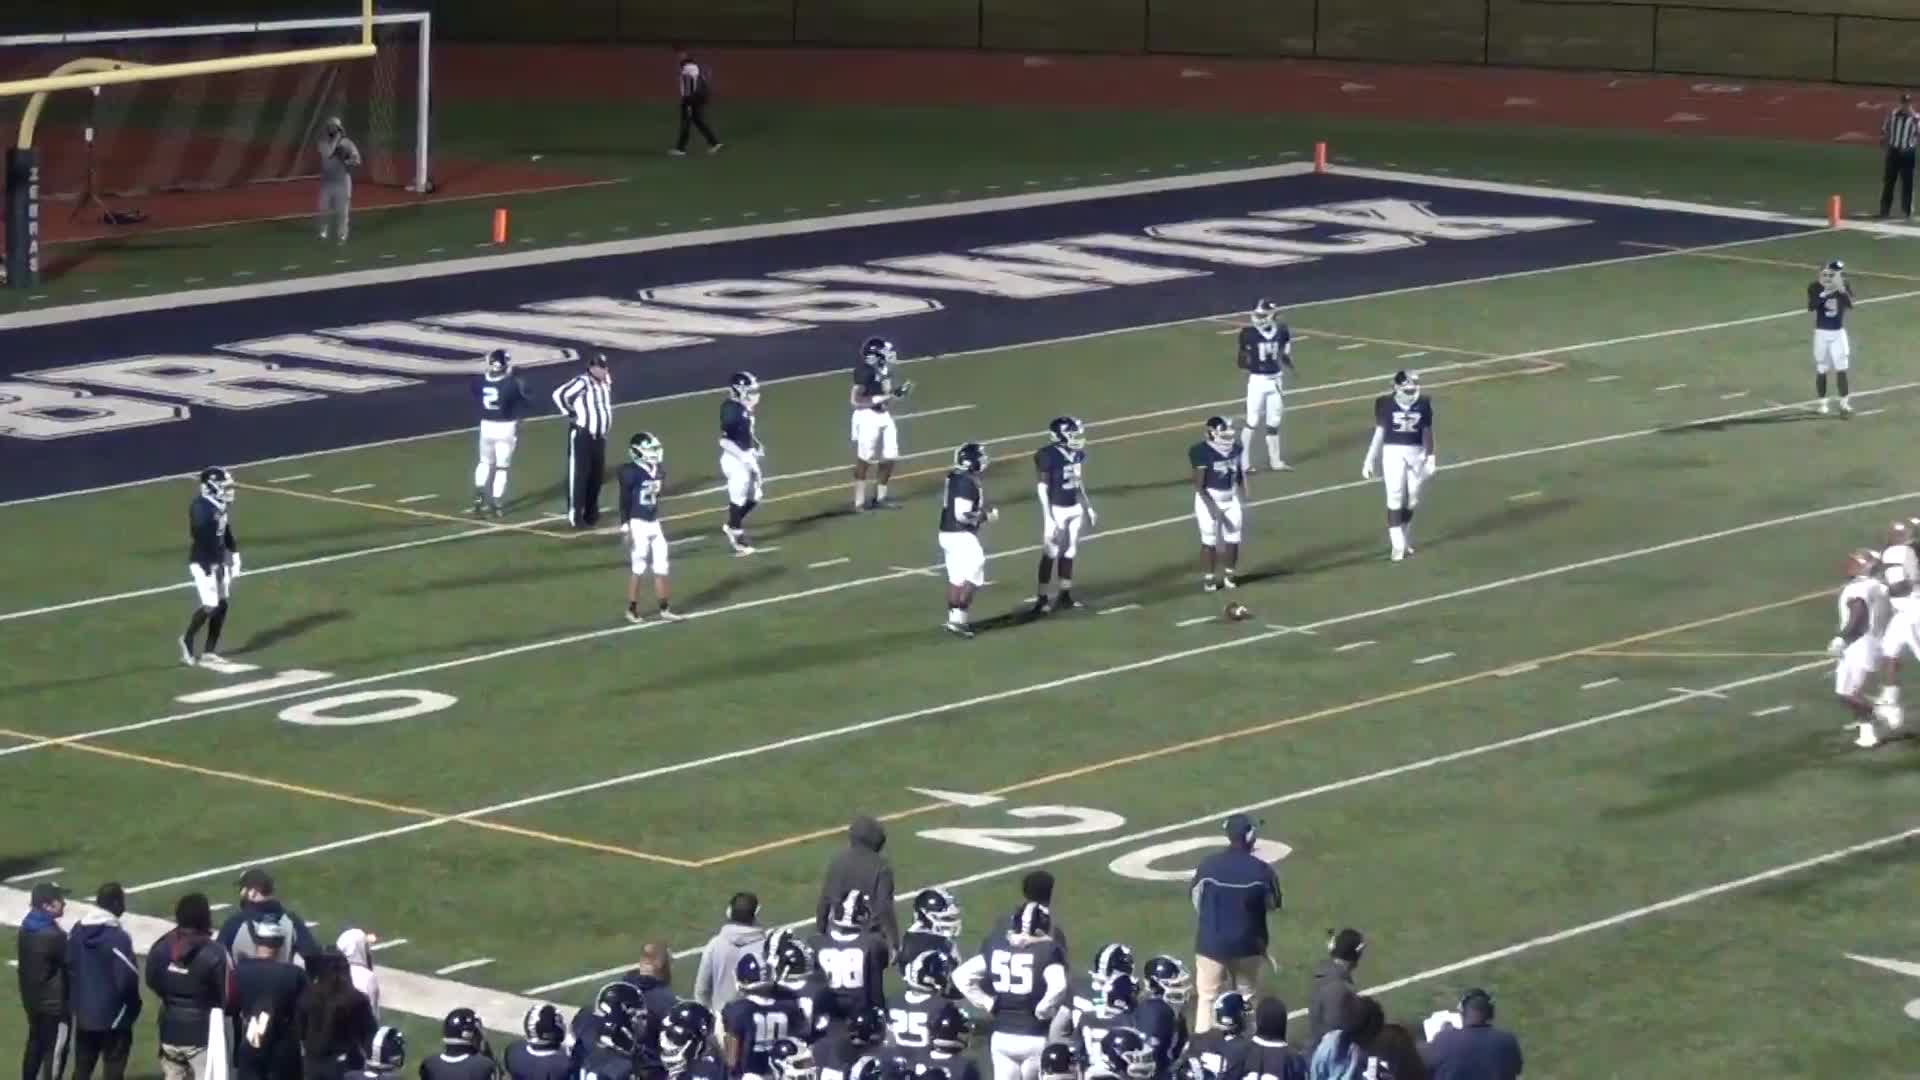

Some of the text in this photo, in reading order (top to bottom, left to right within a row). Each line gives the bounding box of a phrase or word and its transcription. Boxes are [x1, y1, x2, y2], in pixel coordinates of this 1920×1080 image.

[0, 198, 1596, 440] BRUNSWICK
[482, 386, 500, 410] 2
[174, 668, 459, 725] 10
[915, 804, 1293, 881] 20
[991, 950, 1032, 994] 55
